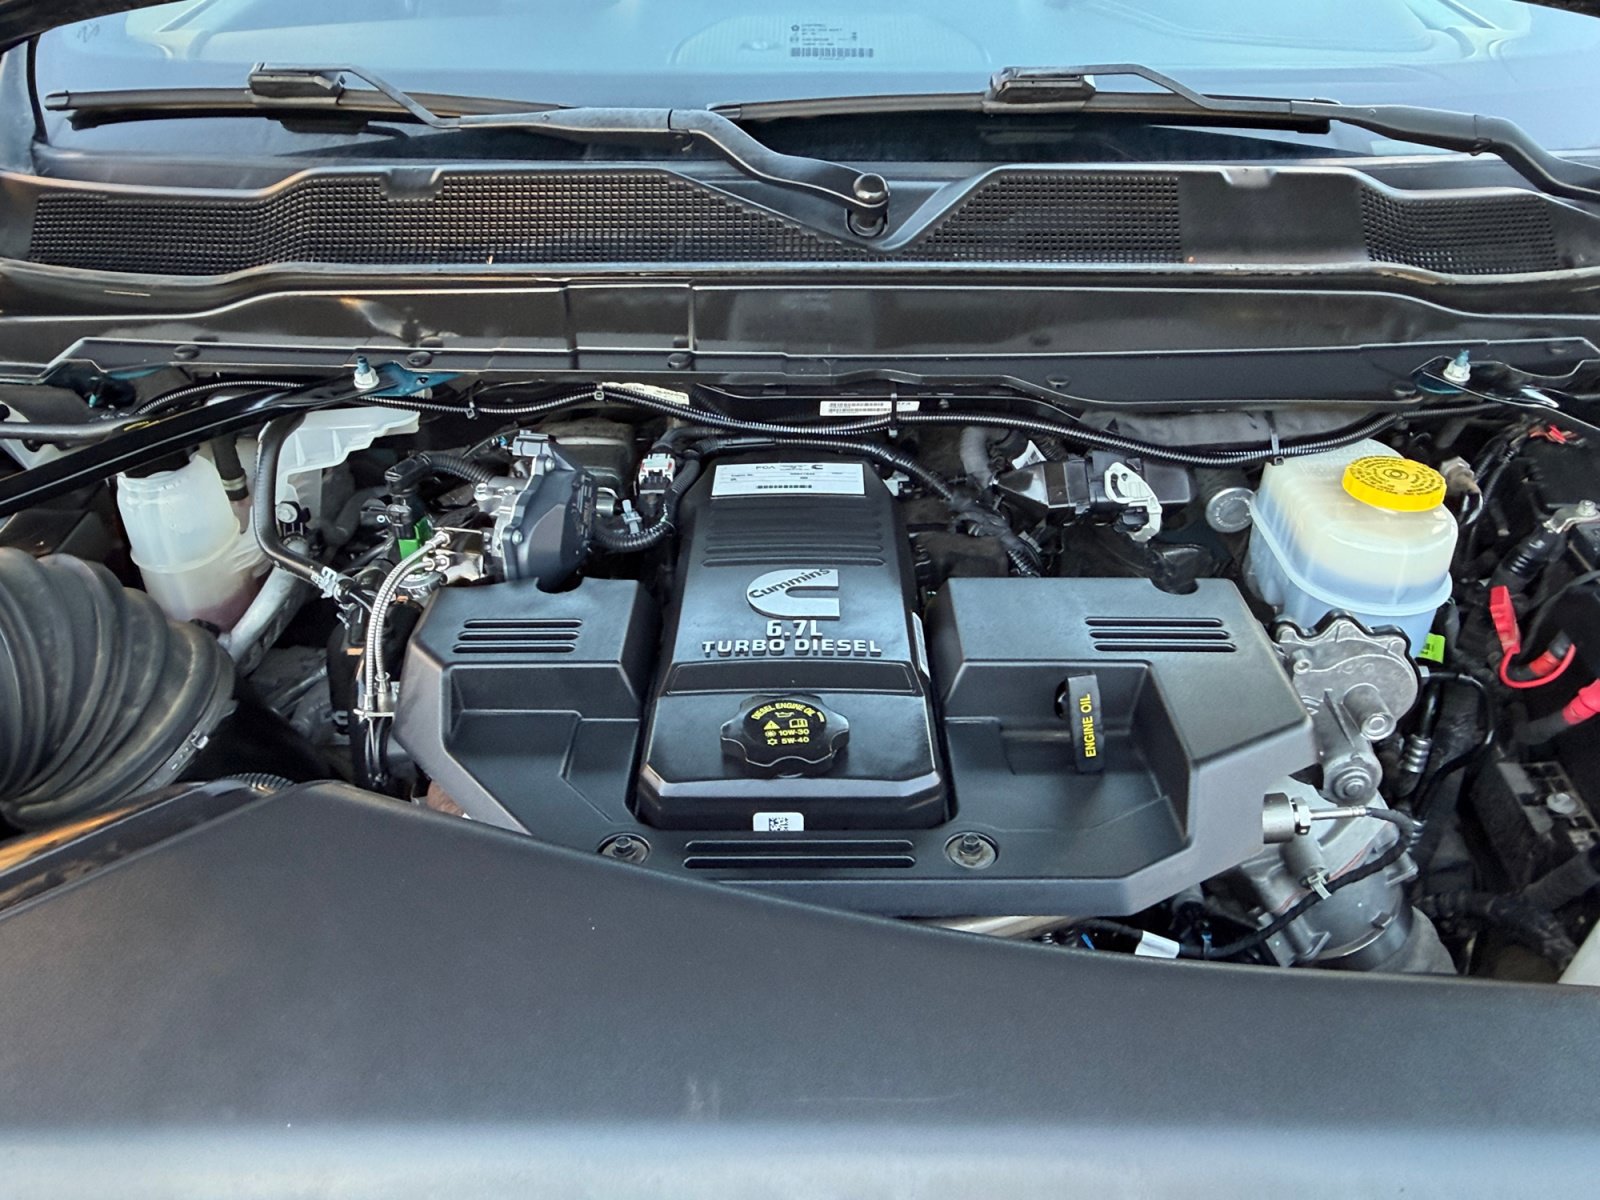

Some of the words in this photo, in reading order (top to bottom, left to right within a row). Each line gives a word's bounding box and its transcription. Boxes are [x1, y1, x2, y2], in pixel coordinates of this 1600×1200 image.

[748, 568, 831, 599] Cummins
[766, 619, 823, 638] 6.7L
[702, 638, 786, 655] TURBO
[794, 638, 882, 655] DIESEL
[751, 704, 776, 721] DIESEL
[775, 702, 806, 712] ENGINE
[1080, 693, 1092, 713] OIL
[779, 728, 810, 737] 10W-30
[781, 736, 810, 745] 5W-40
[1082, 715, 1097, 758] ENGINE
